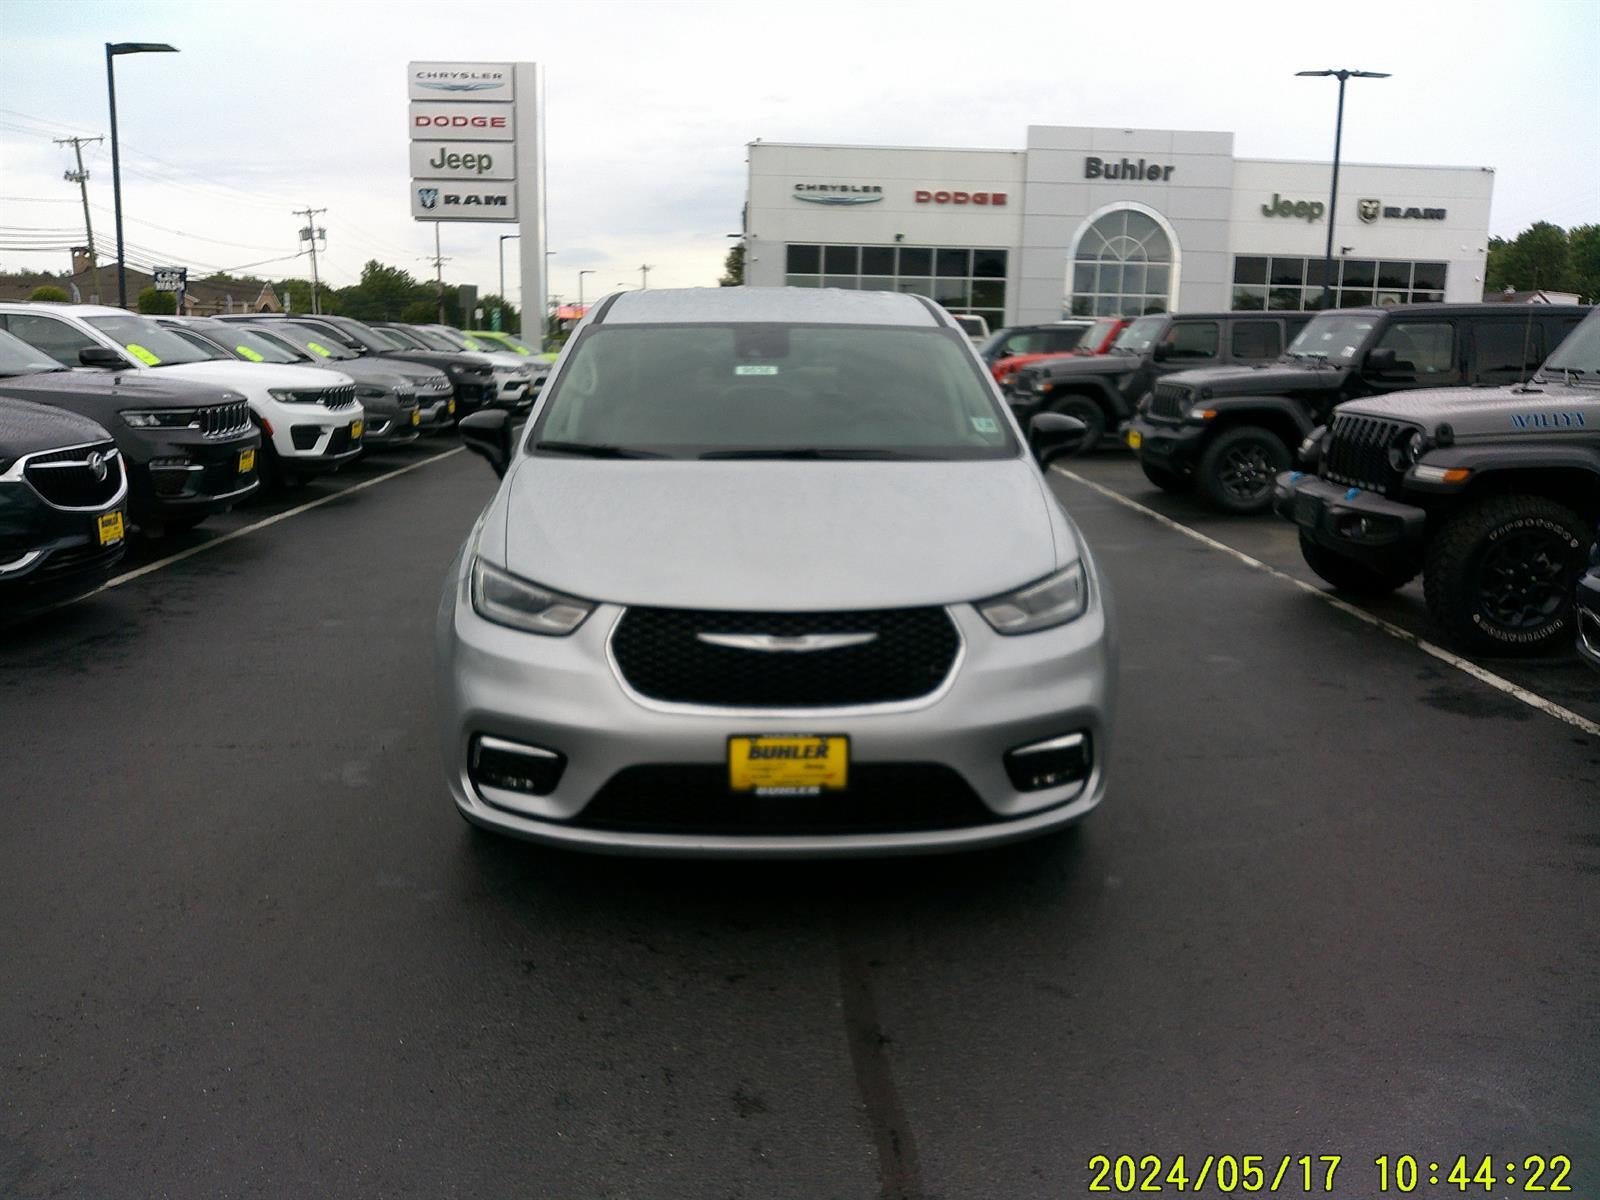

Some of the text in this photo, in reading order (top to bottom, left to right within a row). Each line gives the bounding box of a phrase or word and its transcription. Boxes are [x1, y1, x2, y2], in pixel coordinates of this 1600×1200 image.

[416, 71, 503, 80] CHRYSLER
[415, 115, 506, 128] DODGE
[430, 147, 493, 175] Jeep
[1084, 156, 1175, 182] Buhler
[794, 183, 883, 193] CHRYSLER
[443, 194, 508, 206] RAM
[914, 190, 1008, 206] DODGE
[1261, 193, 1325, 224] Jeep
[1382, 206, 1448, 220] RAM
[748, 744, 830, 760] BUHLER
